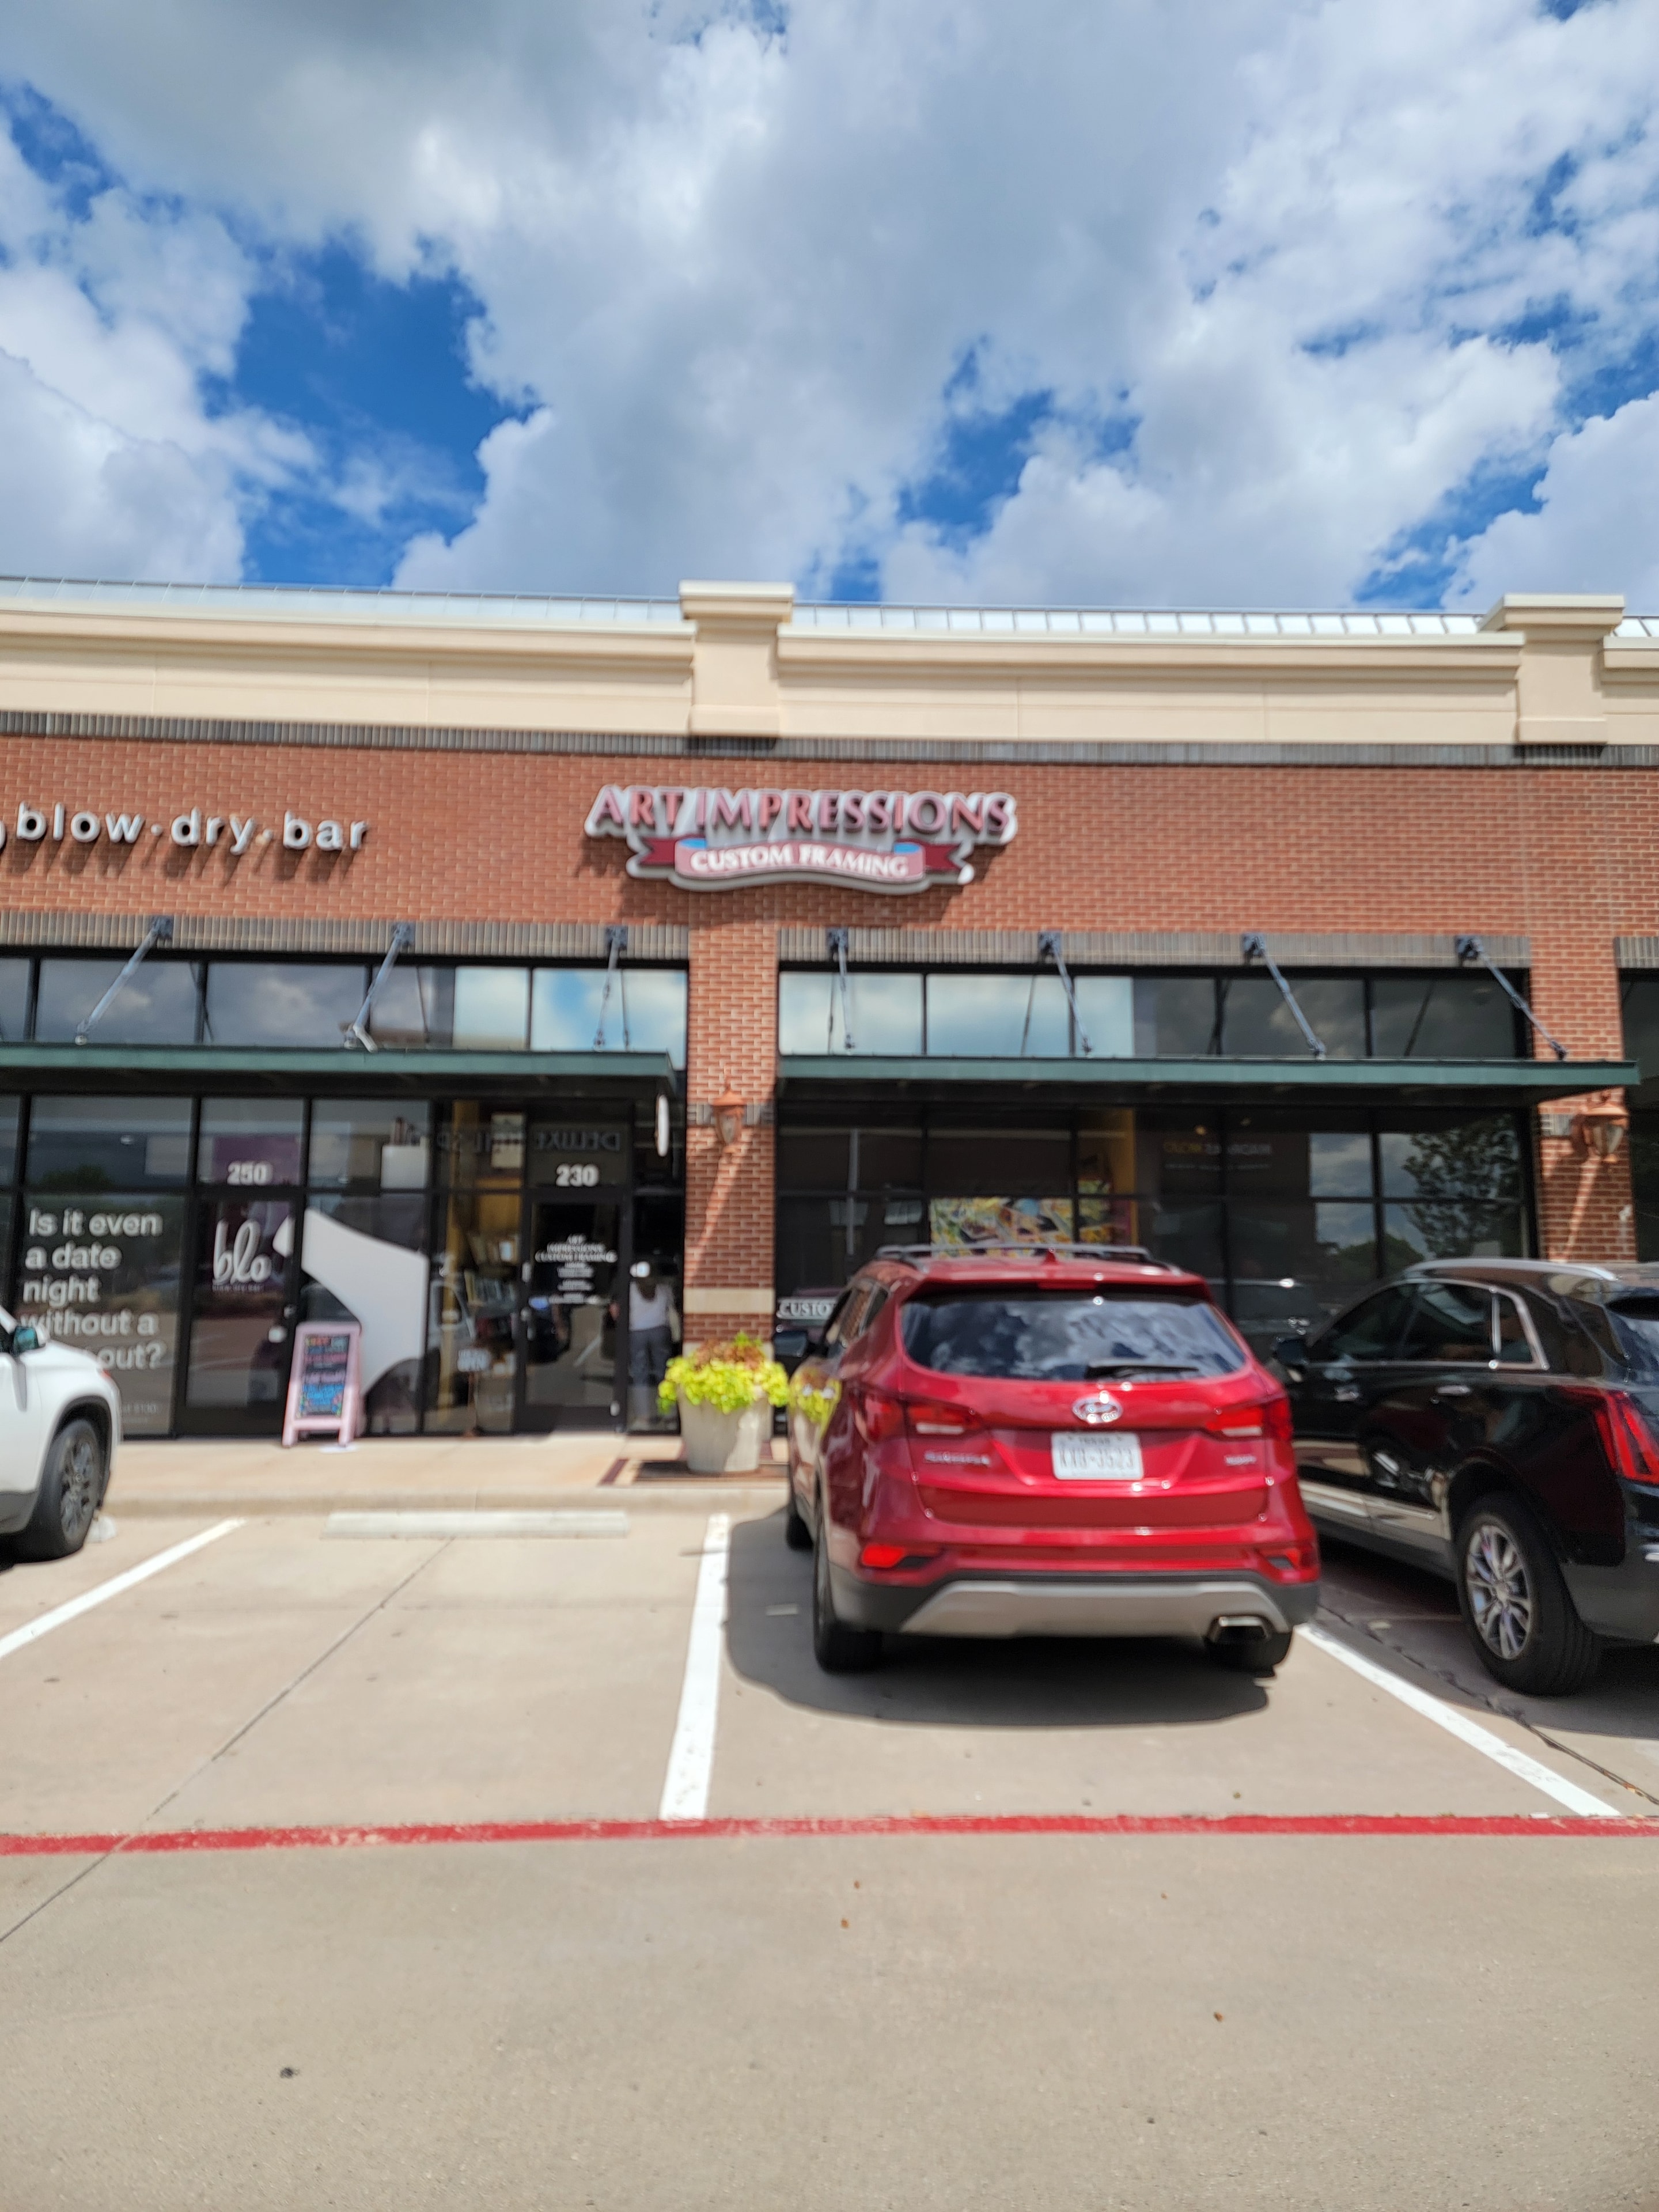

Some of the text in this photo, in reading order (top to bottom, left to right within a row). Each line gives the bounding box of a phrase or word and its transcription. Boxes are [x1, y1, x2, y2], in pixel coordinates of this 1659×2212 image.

[592, 786, 1009, 834] ART IMPRESSIONS
[691, 843, 909, 877] CUSTOM FRAMING
[228, 1161, 273, 1185] 250
[555, 1164, 600, 1187] 230
[29, 1207, 164, 1237] Is it even
[25, 1240, 123, 1270] a date
[213, 1217, 272, 1284] blo
[23, 1274, 102, 1309] night
[137, 1313, 160, 1336] a
[779, 1302, 835, 1317] CUSTO
